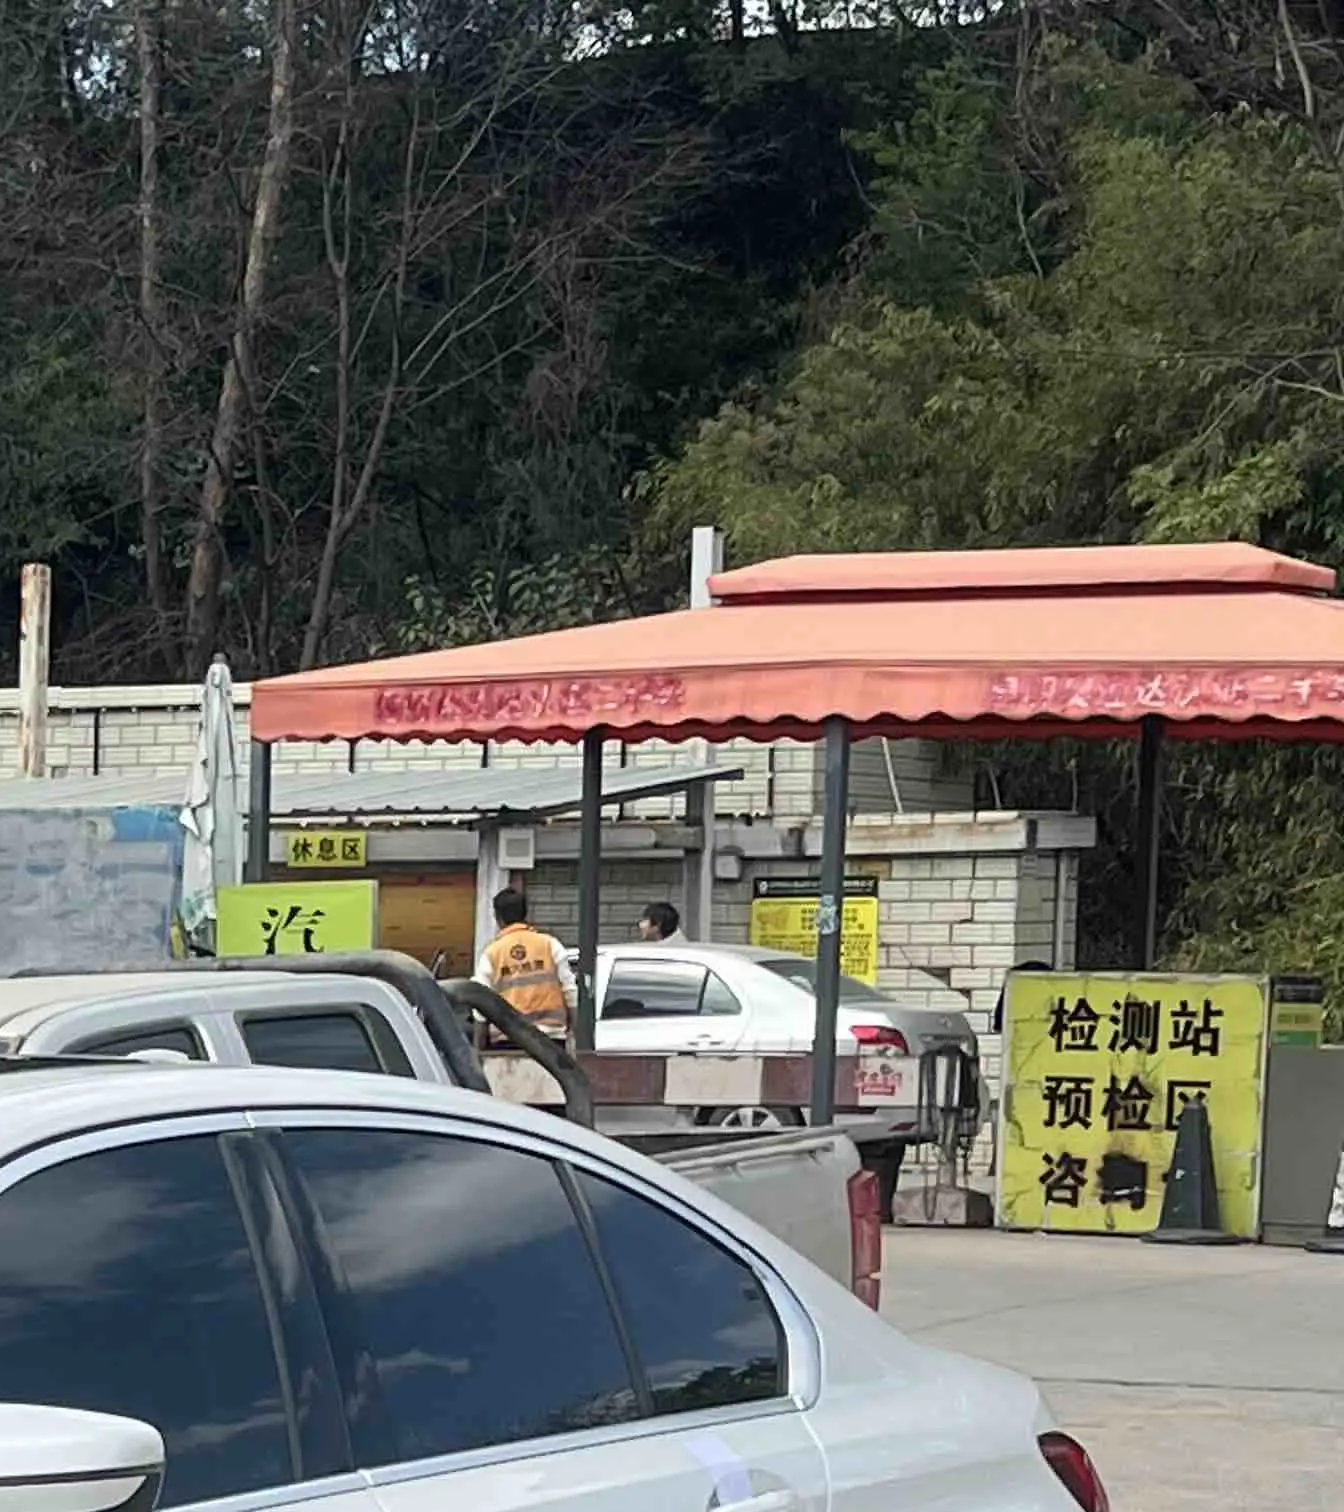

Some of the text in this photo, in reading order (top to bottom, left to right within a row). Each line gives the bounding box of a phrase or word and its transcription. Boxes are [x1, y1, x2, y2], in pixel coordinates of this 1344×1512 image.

[292, 838, 360, 862] 休息区
[1049, 996, 1224, 1057] 检测站
[1042, 1075, 1212, 1132] 预检区
